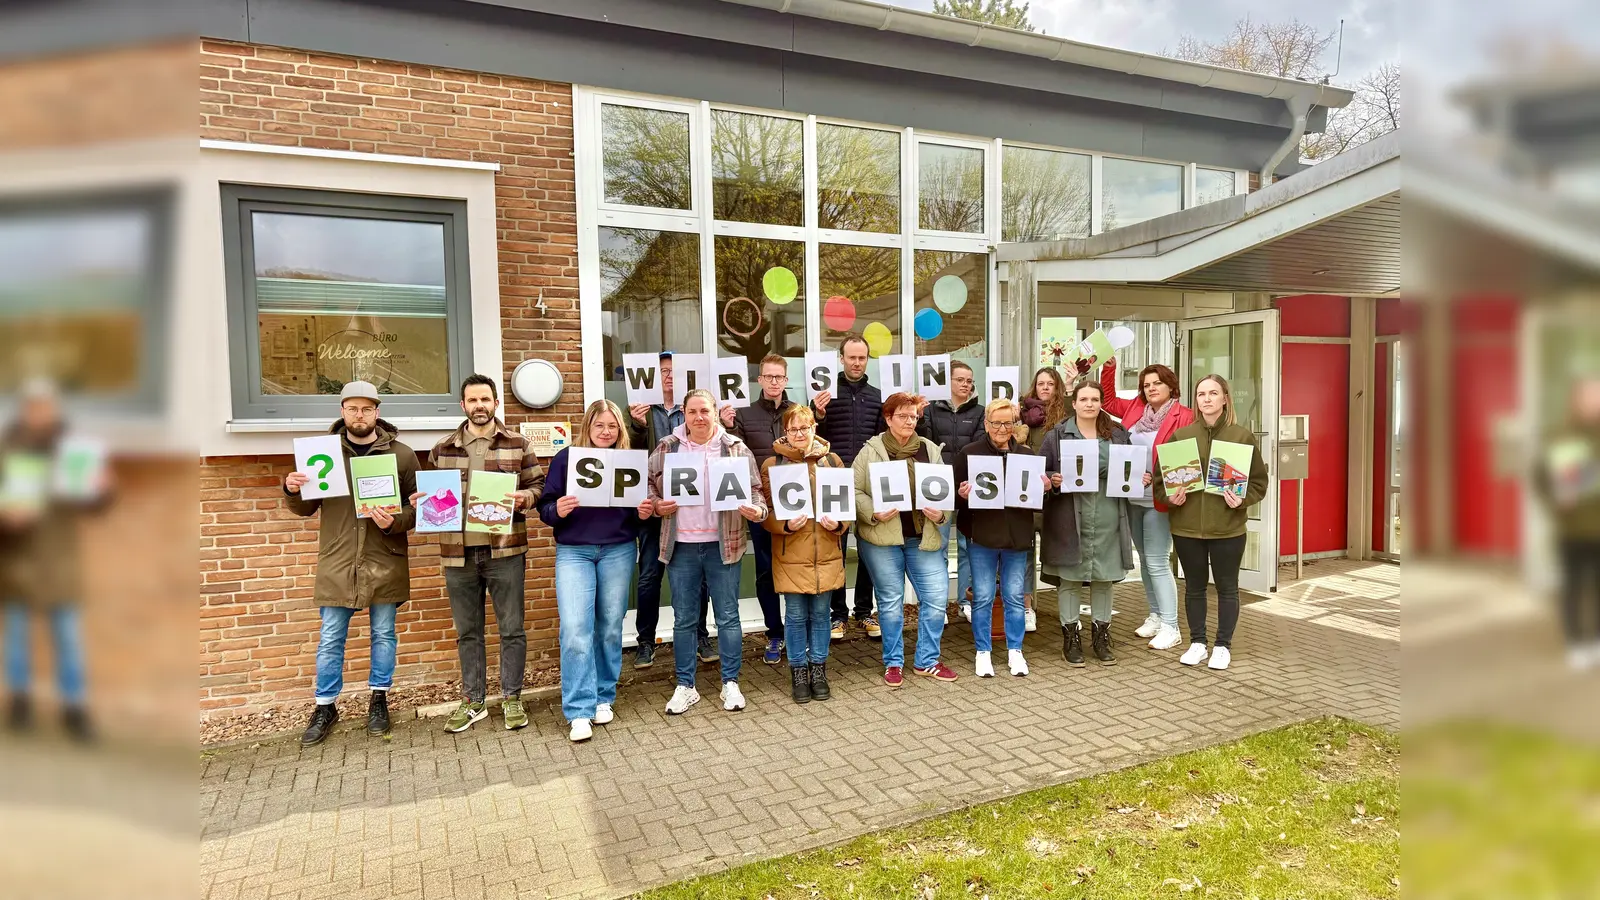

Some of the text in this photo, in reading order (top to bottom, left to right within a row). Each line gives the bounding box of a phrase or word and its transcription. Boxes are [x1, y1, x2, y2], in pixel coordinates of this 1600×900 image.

[535, 293, 548, 315] 4
[373, 332, 398, 342] BÜRO
[317, 343, 392, 360] Welcome
[306, 453, 334, 491] ?
